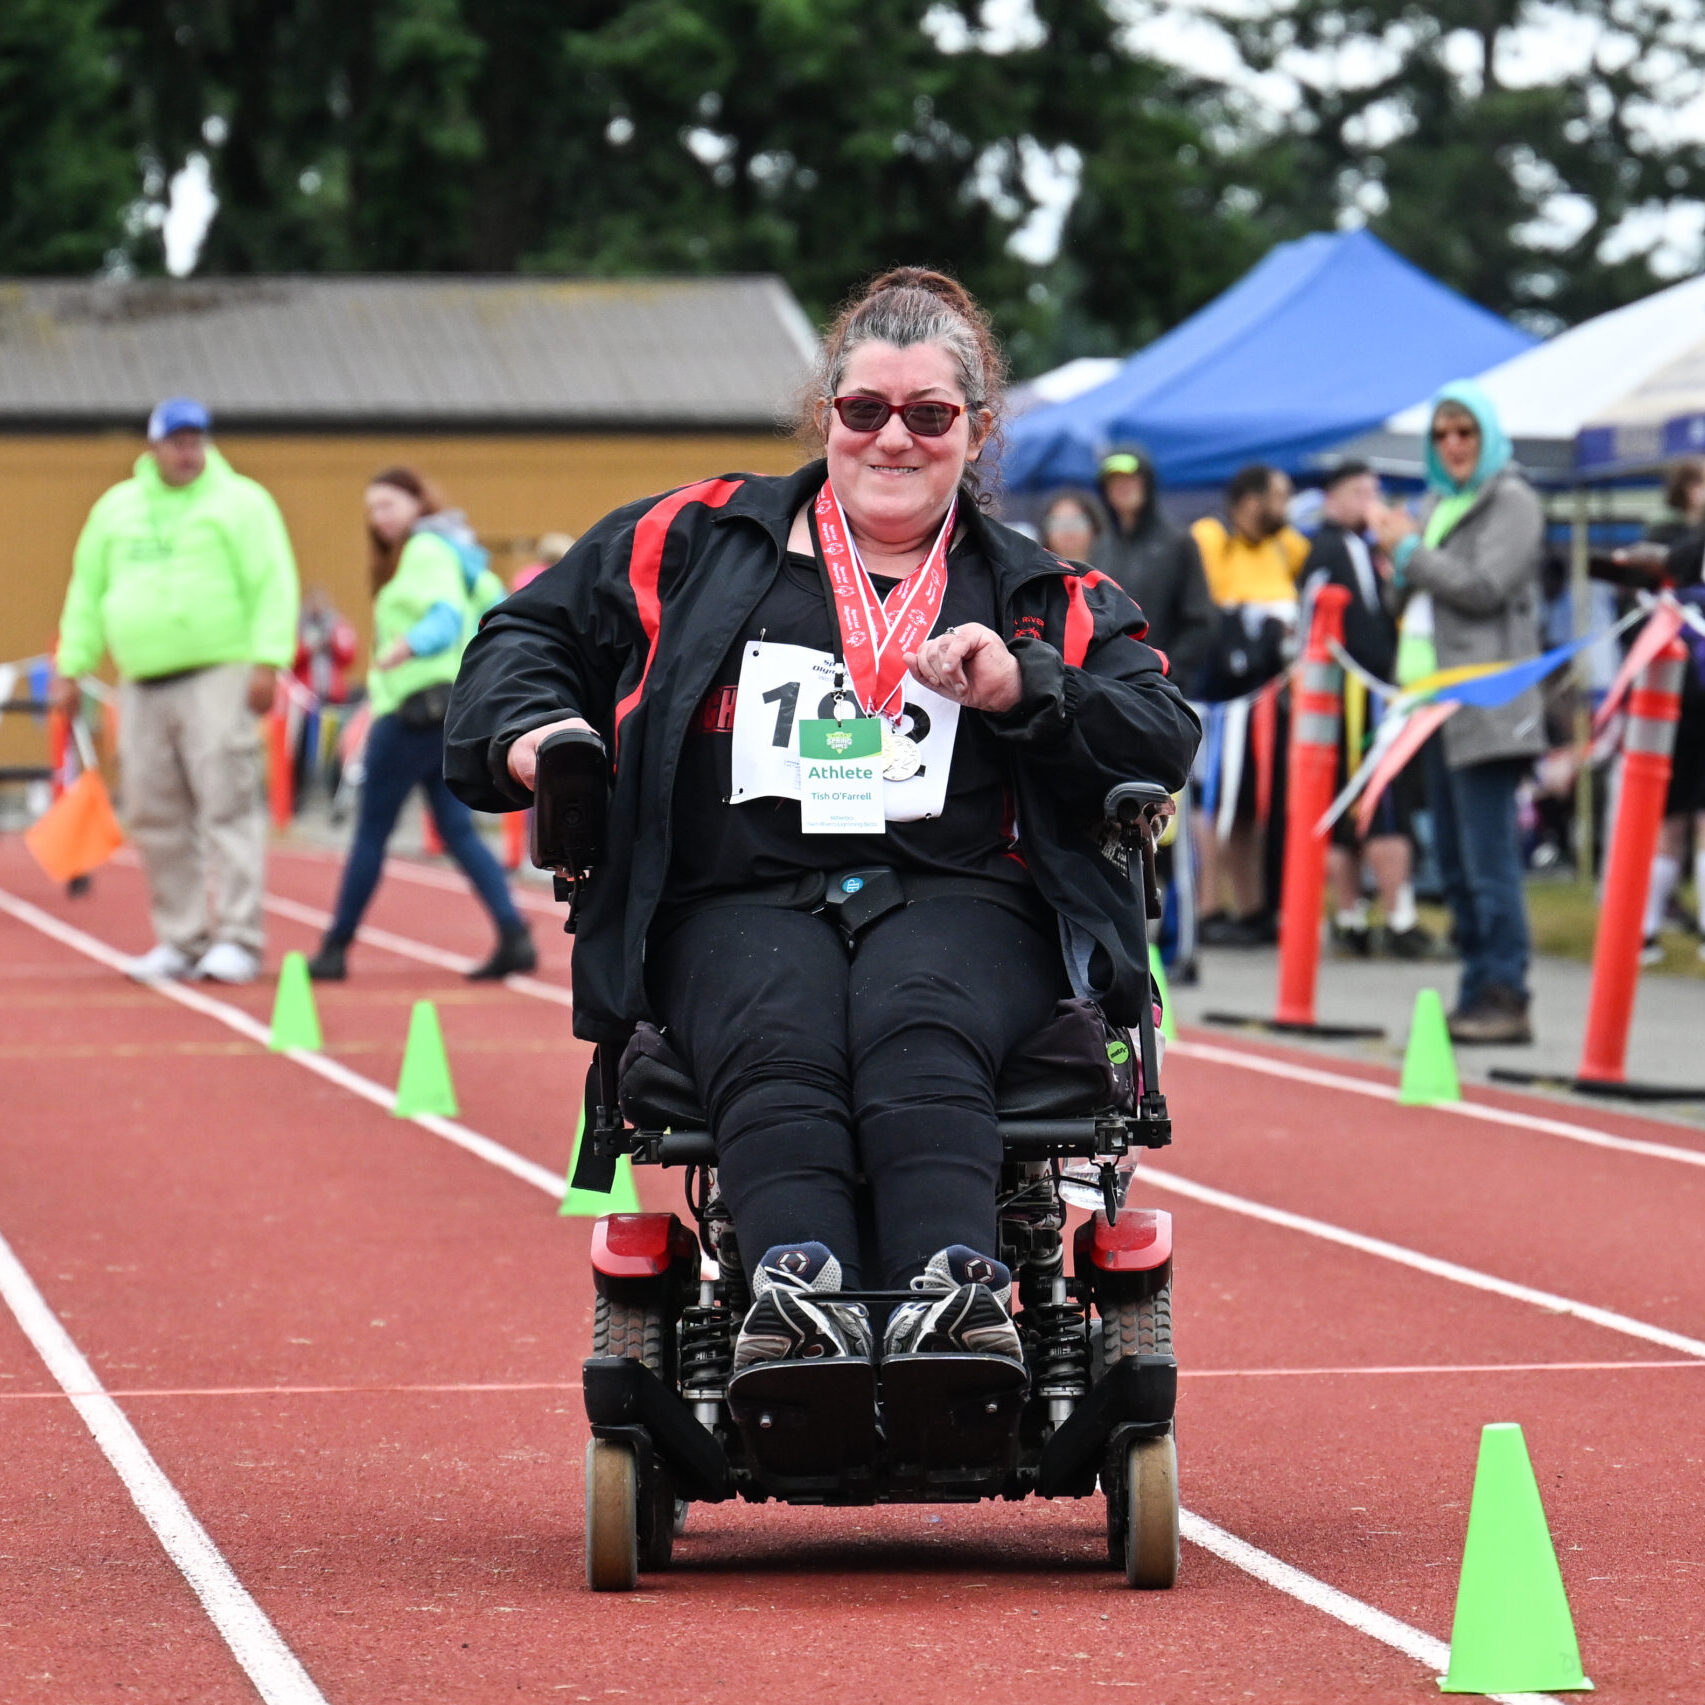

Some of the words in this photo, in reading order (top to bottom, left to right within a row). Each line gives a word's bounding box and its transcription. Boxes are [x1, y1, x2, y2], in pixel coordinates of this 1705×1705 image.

[808, 765, 873, 780] Athlete
[811, 792, 830, 801] Tish
[832, 792, 872, 801] O'Farrell
